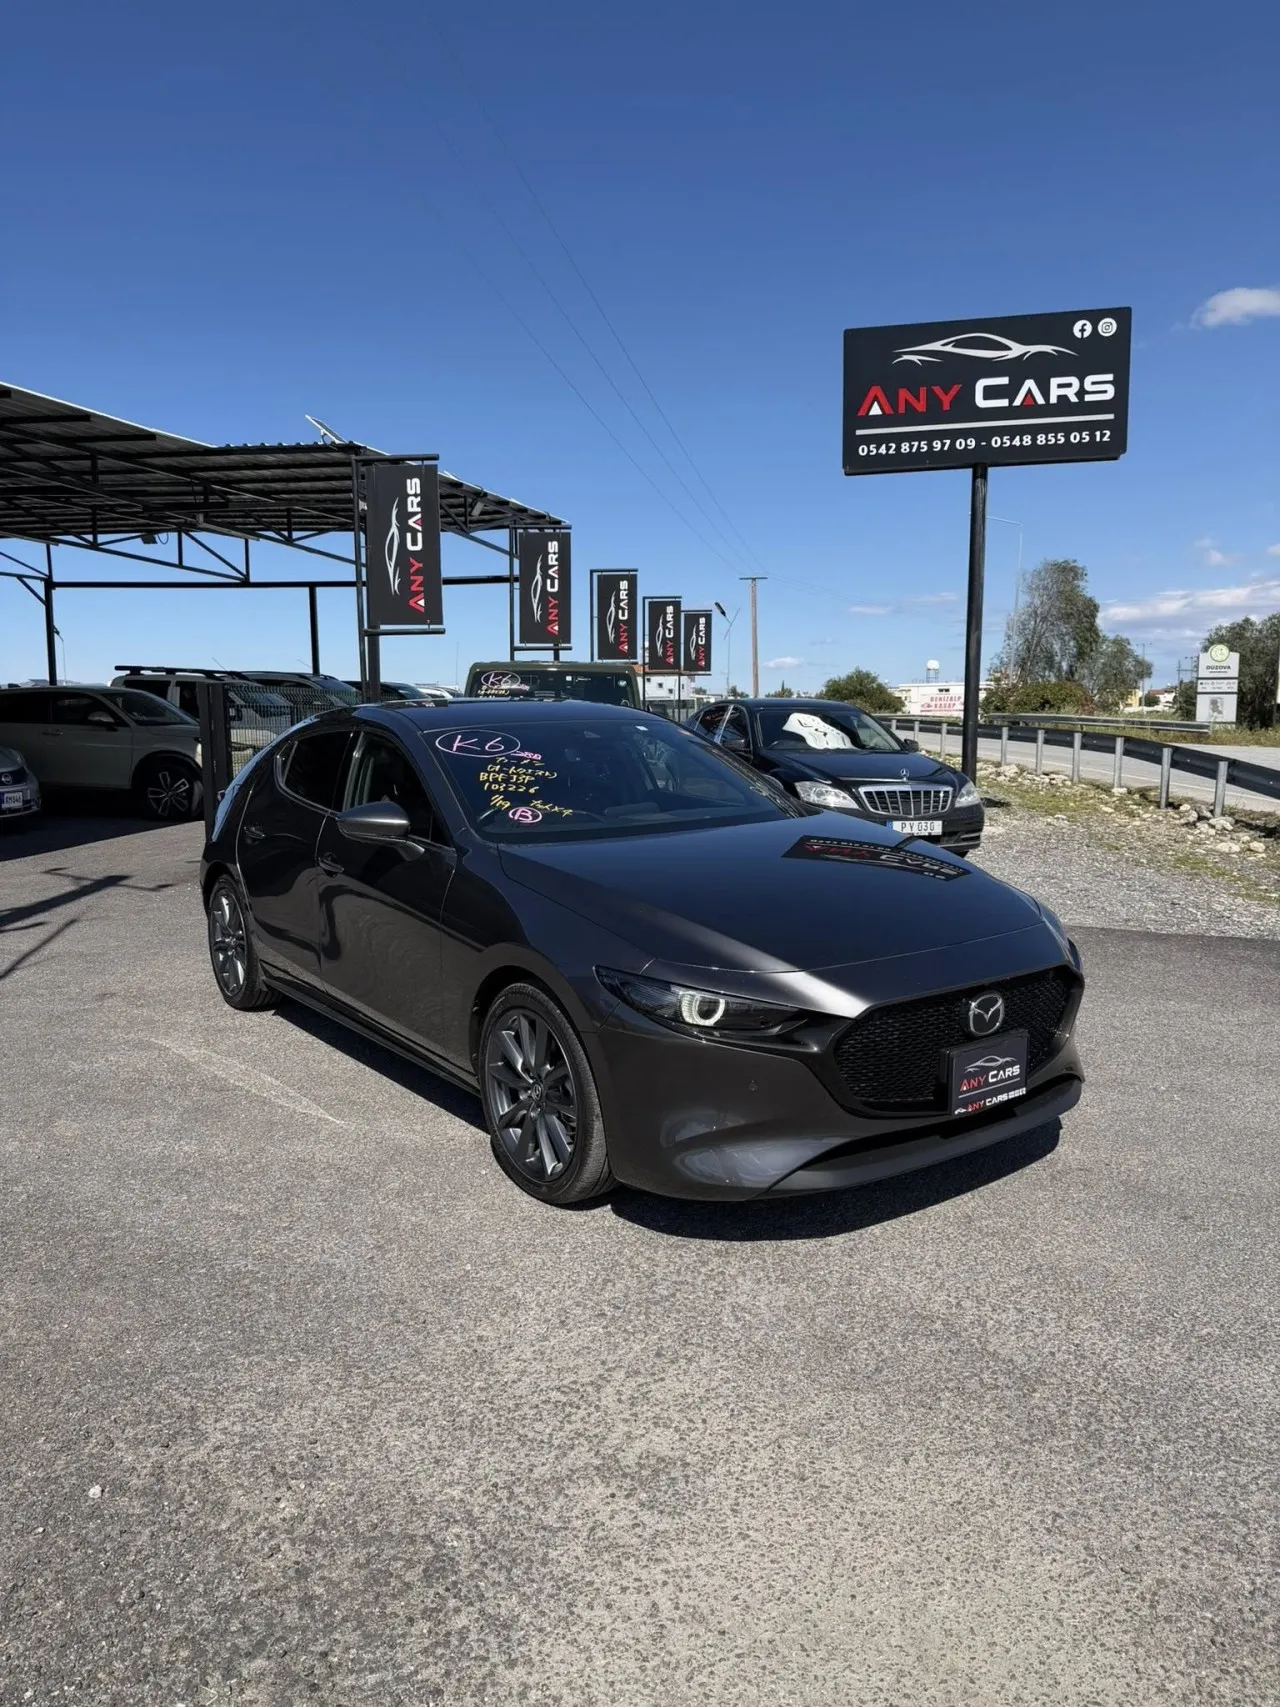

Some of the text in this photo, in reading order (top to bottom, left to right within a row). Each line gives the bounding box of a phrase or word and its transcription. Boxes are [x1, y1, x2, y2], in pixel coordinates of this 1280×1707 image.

[856, 374, 1115, 416] ANY CARS
[858, 441, 896, 456] 0542
[900, 440, 928, 453] 875
[932, 439, 951, 451] 97
[955, 437, 976, 449] 09
[991, 435, 1032, 448] 0548
[1036, 433, 1065, 445] 855
[1070, 431, 1090, 443] 05
[1095, 430, 1111, 442] 12
[406, 477, 425, 613] ANY CARS
[546, 540, 559, 635] ANY CARS
[619, 580, 628, 652] ANY CARS
[665, 605, 674, 664] ANY CARS
[698, 617, 706, 645] CARS
[960, 1065, 1020, 1091] ANY CARS
[986, 1093, 1008, 1106] CARS
